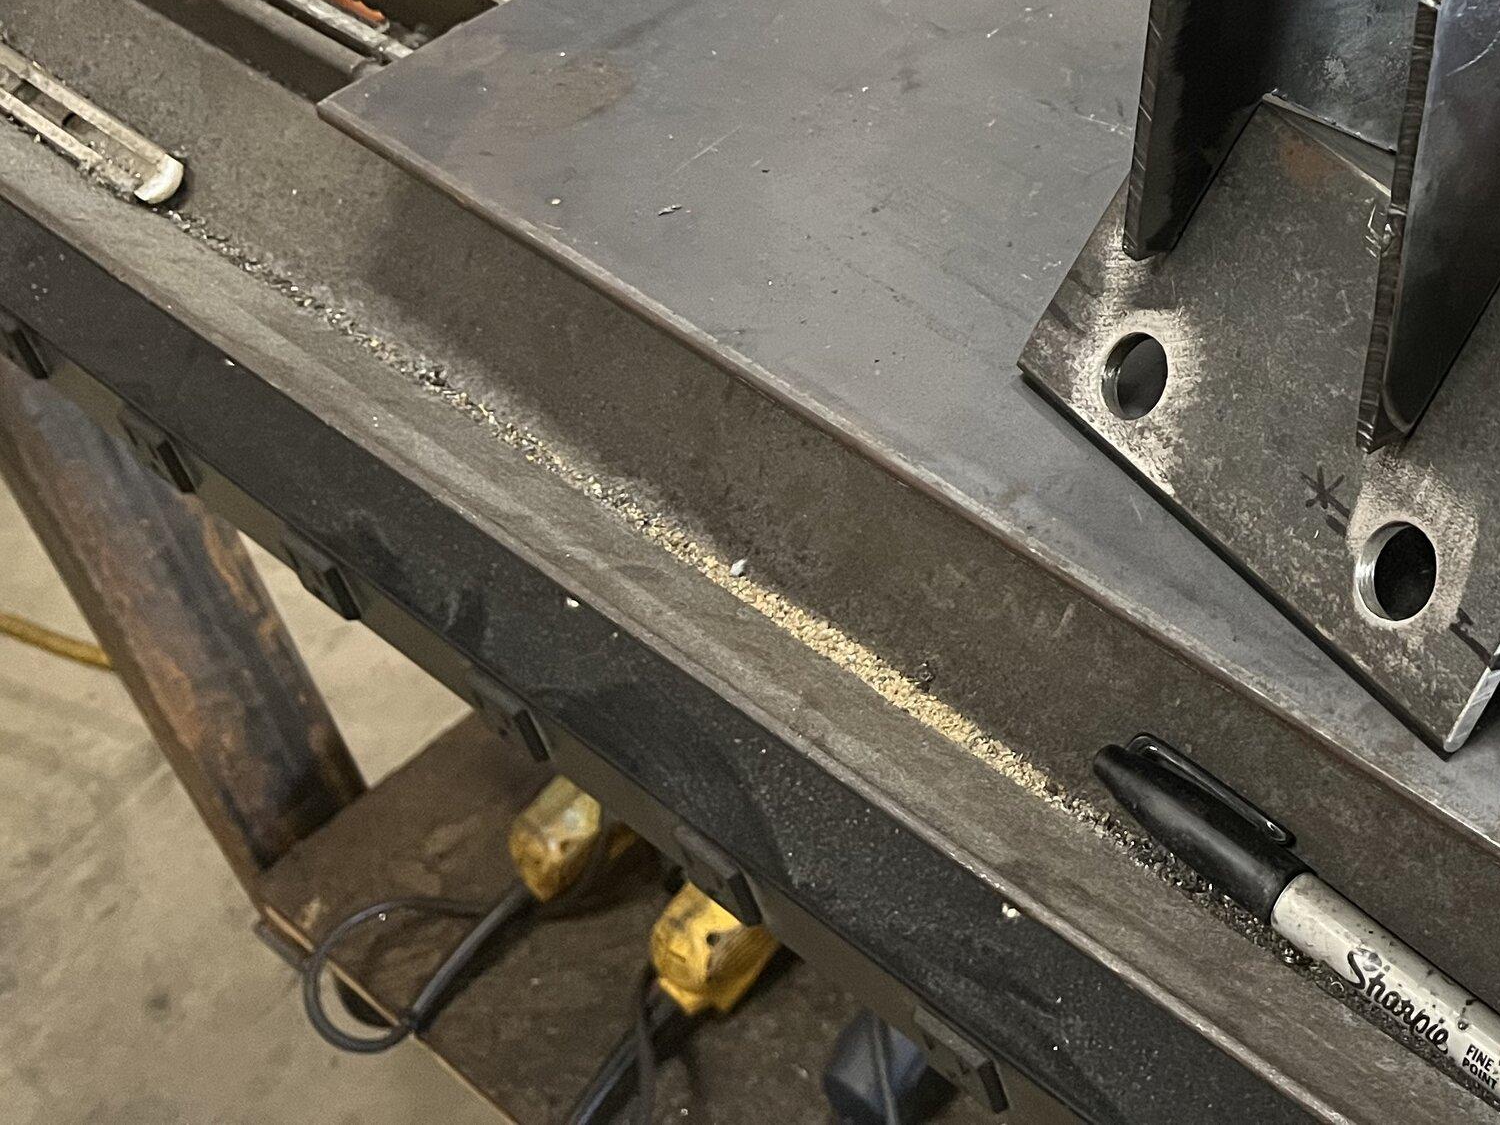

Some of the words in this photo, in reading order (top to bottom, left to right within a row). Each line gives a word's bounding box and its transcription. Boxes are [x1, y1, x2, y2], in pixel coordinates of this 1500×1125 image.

[1347, 947, 1450, 1055] Sharpie
[1462, 1056, 1498, 1090] POINT
[1466, 1044, 1495, 1072] FINE
